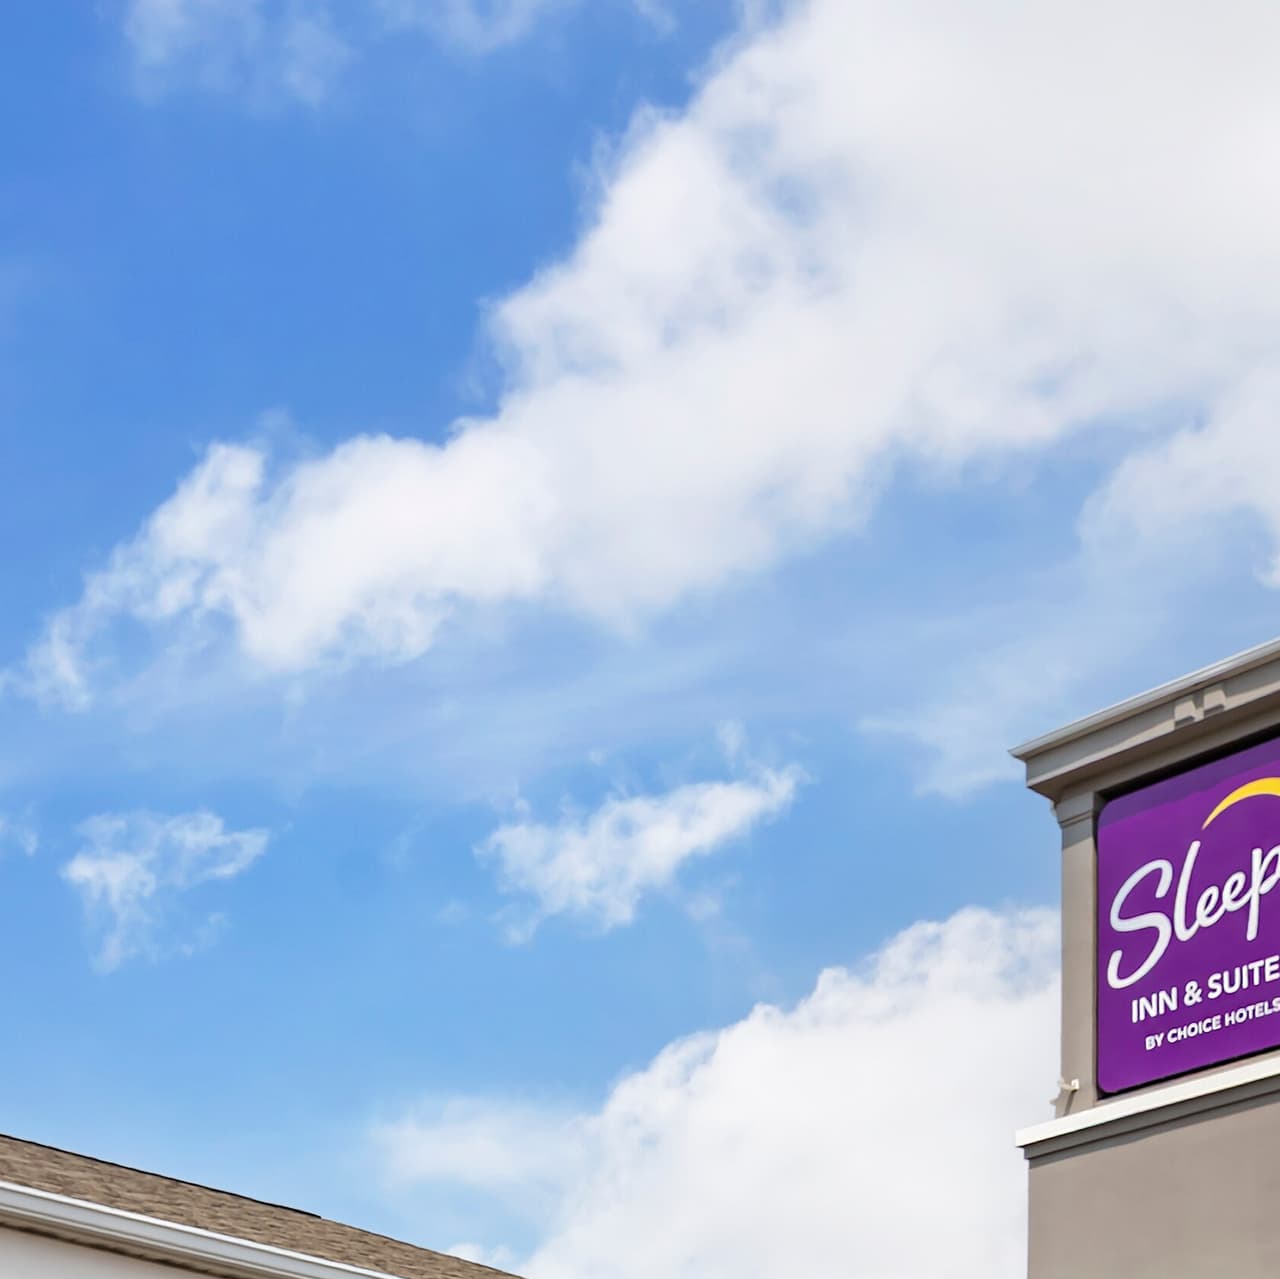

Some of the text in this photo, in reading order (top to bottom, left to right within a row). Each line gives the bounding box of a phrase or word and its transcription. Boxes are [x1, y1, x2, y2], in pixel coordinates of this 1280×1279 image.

[1131, 986, 1178, 1024] INN
[1183, 980, 1203, 1007] &
[1145, 1033, 1165, 1051] BY
[1167, 1015, 1222, 1043] CHOICE
